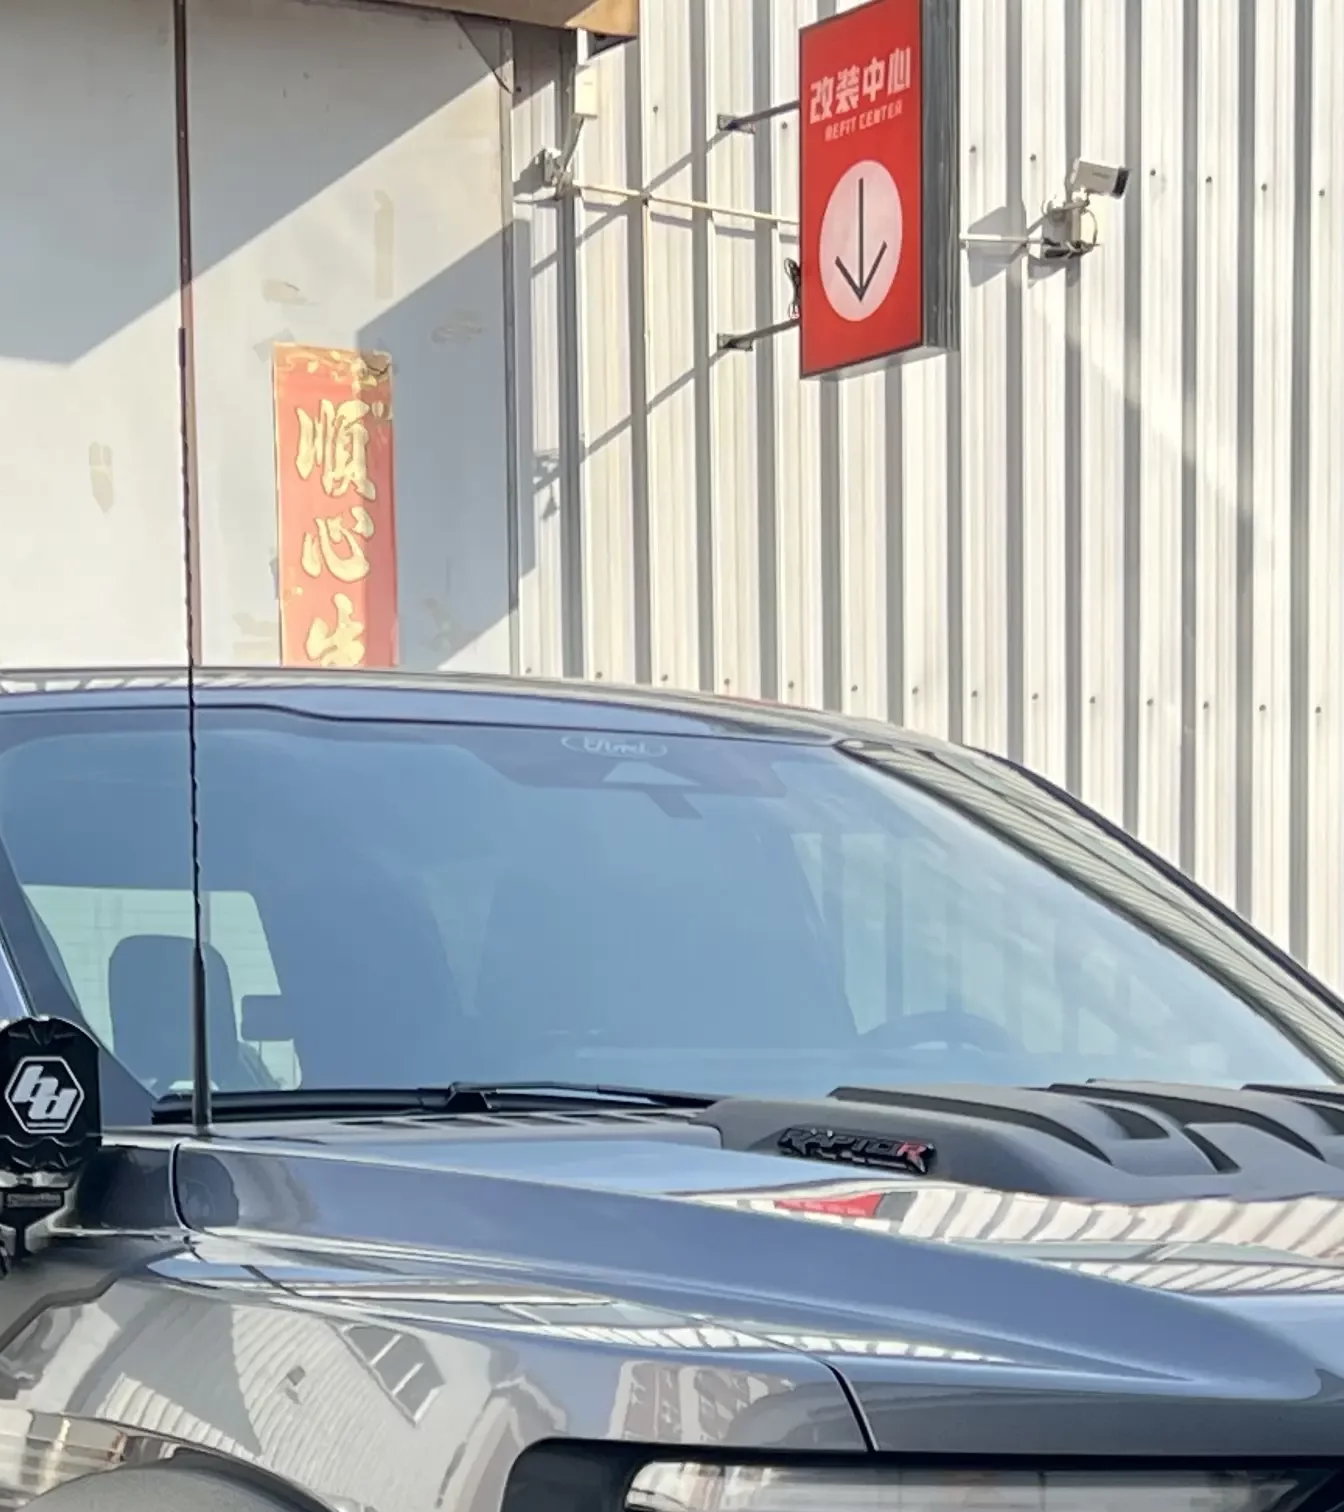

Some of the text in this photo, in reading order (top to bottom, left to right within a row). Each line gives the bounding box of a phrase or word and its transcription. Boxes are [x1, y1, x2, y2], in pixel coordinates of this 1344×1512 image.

[809, 46, 911, 125] 改装中心
[824, 99, 903, 142] REFIT CENTER
[778, 1128, 935, 1174] RAPTOR
